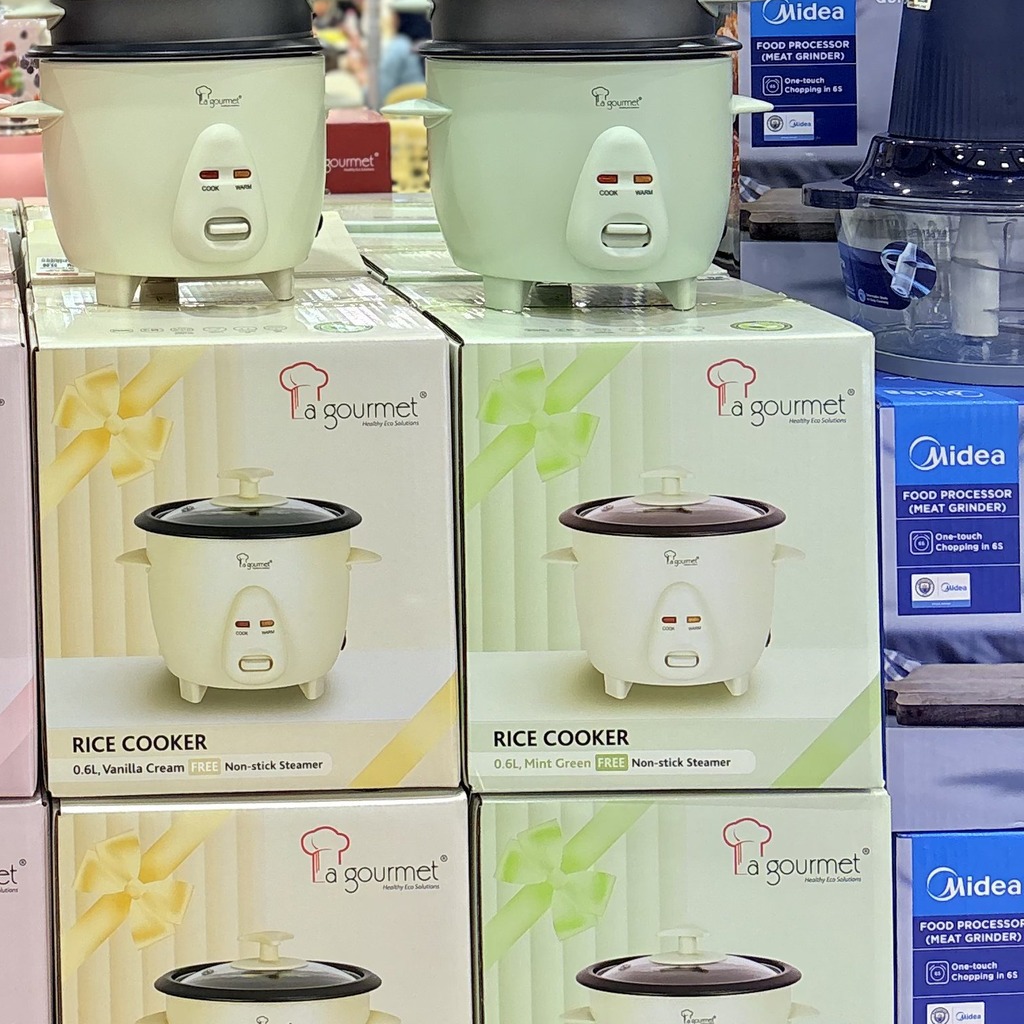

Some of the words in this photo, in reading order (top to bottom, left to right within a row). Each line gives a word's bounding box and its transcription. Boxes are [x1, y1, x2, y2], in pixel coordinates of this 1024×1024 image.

[756, 41, 786, 50] FOOD
[788, 40, 850, 50] PROCESSOR
[761, 52, 792, 62] (MEAT
[795, 52, 845, 61] GRINDER)
[784, 77, 825, 85] One-touch
[784, 85, 822, 94] Chopping
[201, 184, 220, 192] COOK
[323, 397, 418, 430] gourmet
[750, 394, 846, 427] gourmet
[909, 436, 1006, 470] Midea
[902, 490, 937, 501] FOOD
[940, 489, 1013, 500] PROCESSOR
[909, 503, 946, 515] (MEAT
[948, 501, 1007, 514] GRINDER)
[935, 531, 983, 541] One-touch
[935, 542, 978, 553] Chopping
[72, 736, 116, 753] RICE
[122, 734, 208, 752] COOKER
[494, 730, 538, 747] RICE
[543, 728, 630, 747] COOKER
[73, 763, 101, 776] 0.6L,
[102, 762, 143, 775] Vanilla
[146, 762, 185, 774] Cream
[190, 761, 219, 773] FREE
[225, 760, 277, 772] Non-stick
[279, 759, 324, 770] Steamer
[494, 758, 522, 771] 0.6L,
[524, 757, 552, 769] Mint
[556, 757, 592, 769] Green
[597, 756, 626, 769] FREE
[631, 756, 684, 768] Non-stick
[687, 756, 732, 768] Steamer
[344, 860, 439, 893] gourmet
[766, 853, 861, 886] gourmet
[927, 867, 1022, 901] Midea
[919, 920, 954, 931] FOOD
[925, 934, 962, 945] (MEAT
[965, 931, 1022, 943] GRINDER)
[951, 961, 998, 971] One-touch
[951, 971, 995, 982] Chopping
